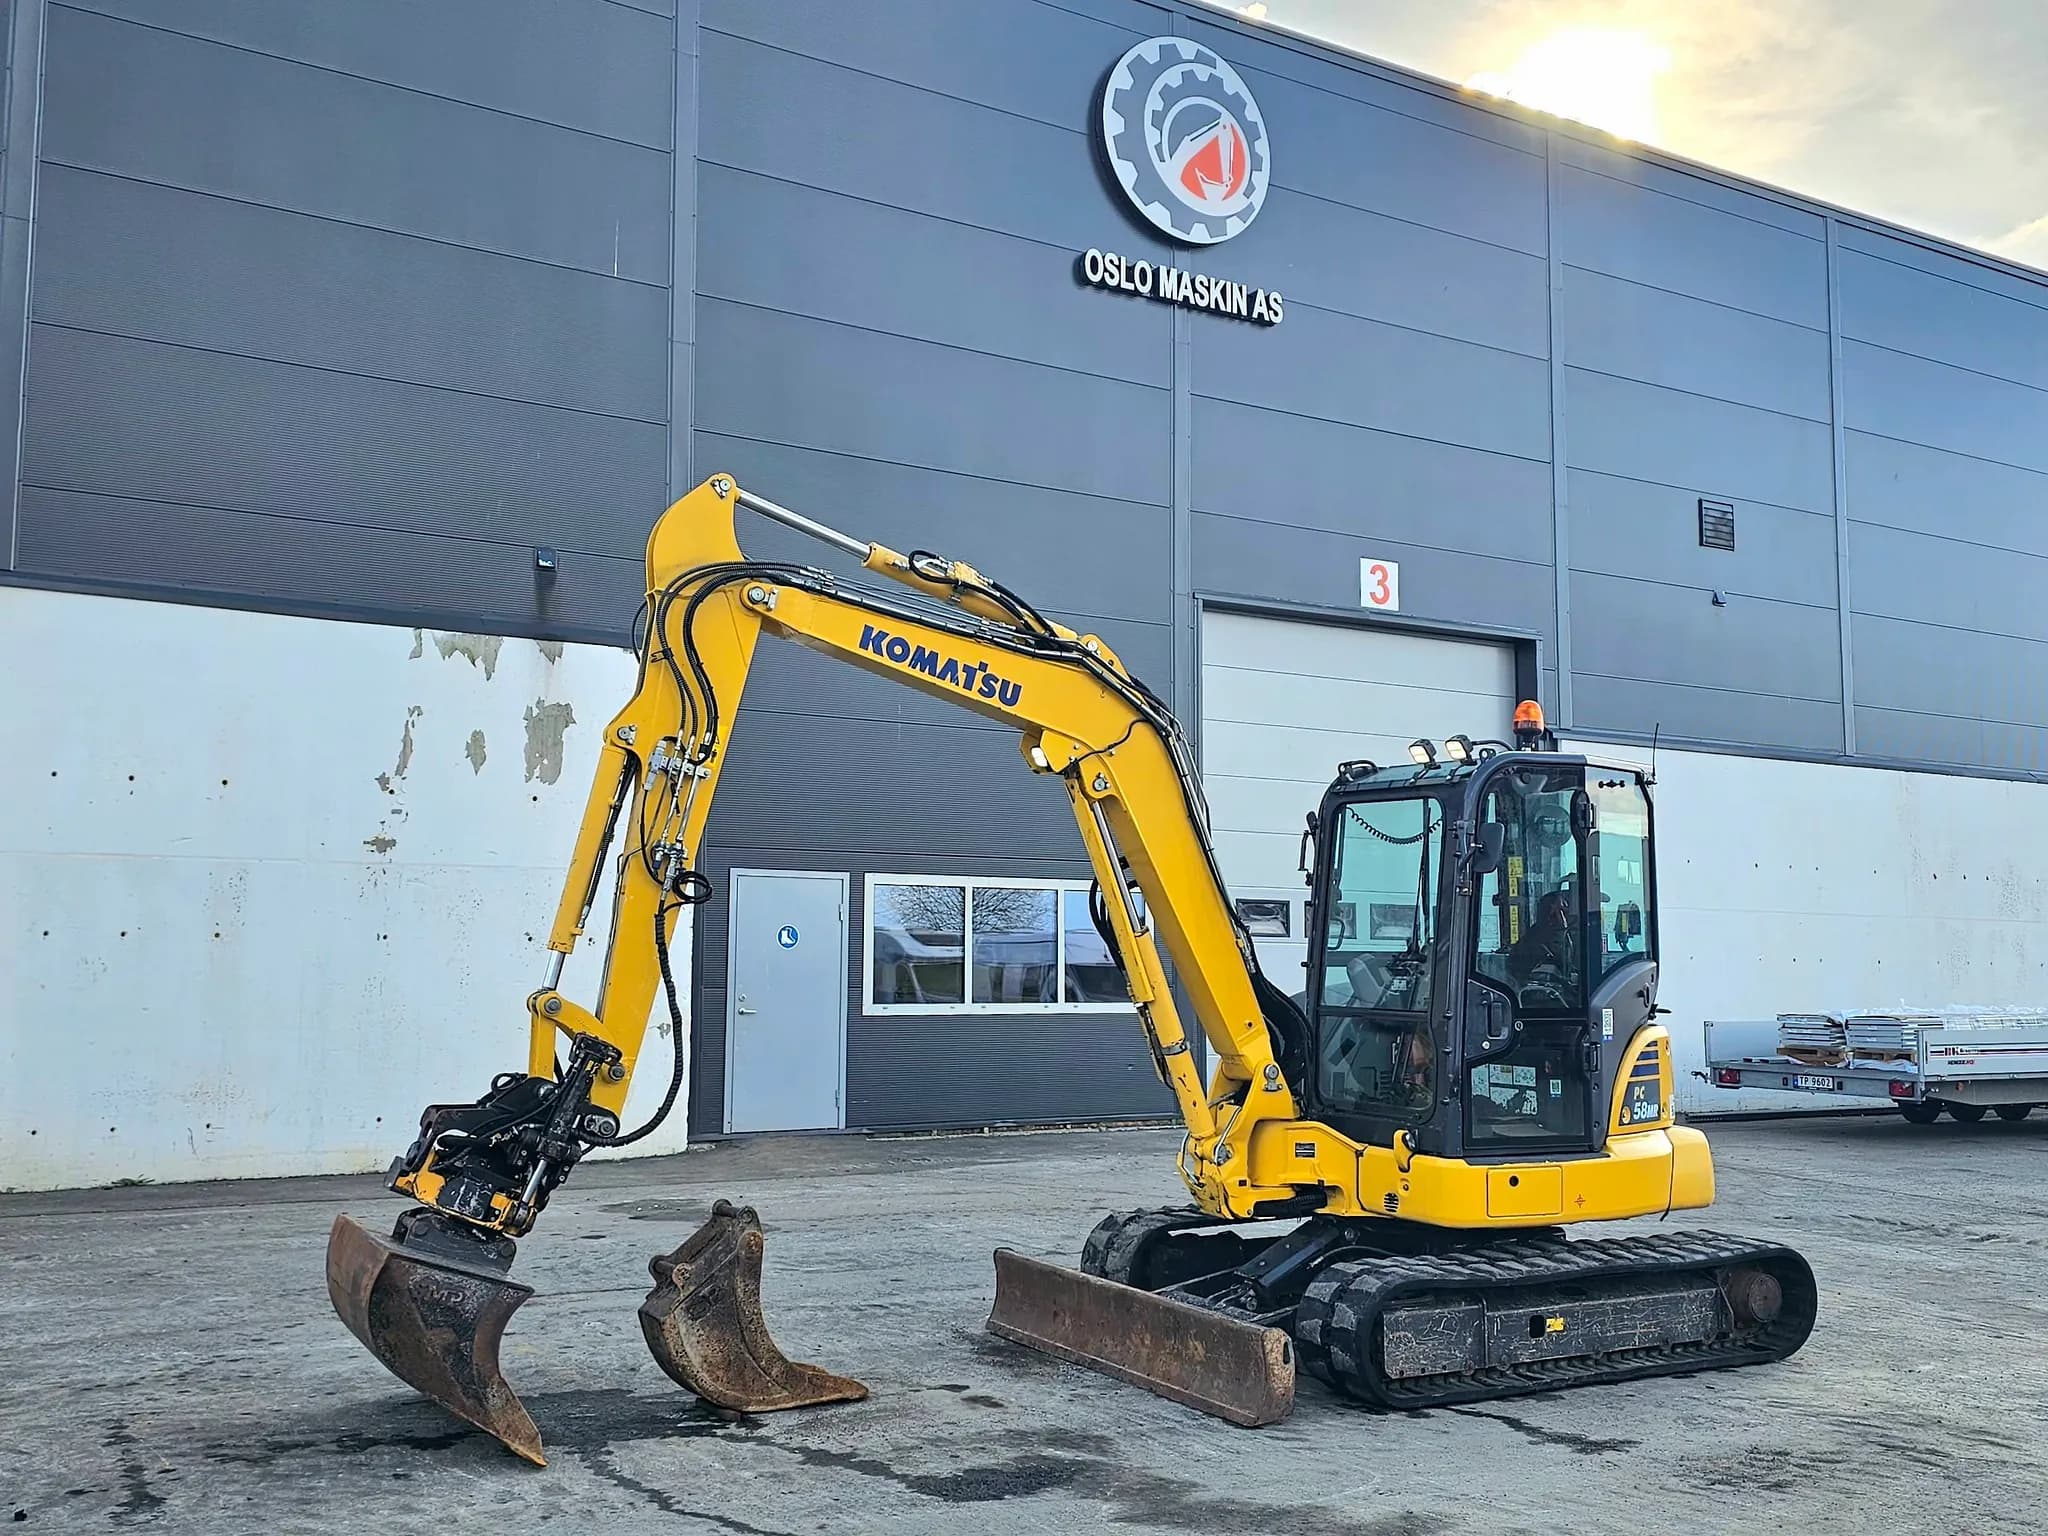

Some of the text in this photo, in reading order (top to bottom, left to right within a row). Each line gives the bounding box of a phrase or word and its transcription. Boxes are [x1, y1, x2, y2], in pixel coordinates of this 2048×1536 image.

[1084, 248, 1285, 324] OSLO MASKIN AS
[1369, 564, 1391, 605] 3
[858, 624, 1023, 707] KOMATSU
[1633, 1085, 1646, 1100] PC
[1799, 1076, 1831, 1088] TP 9602
